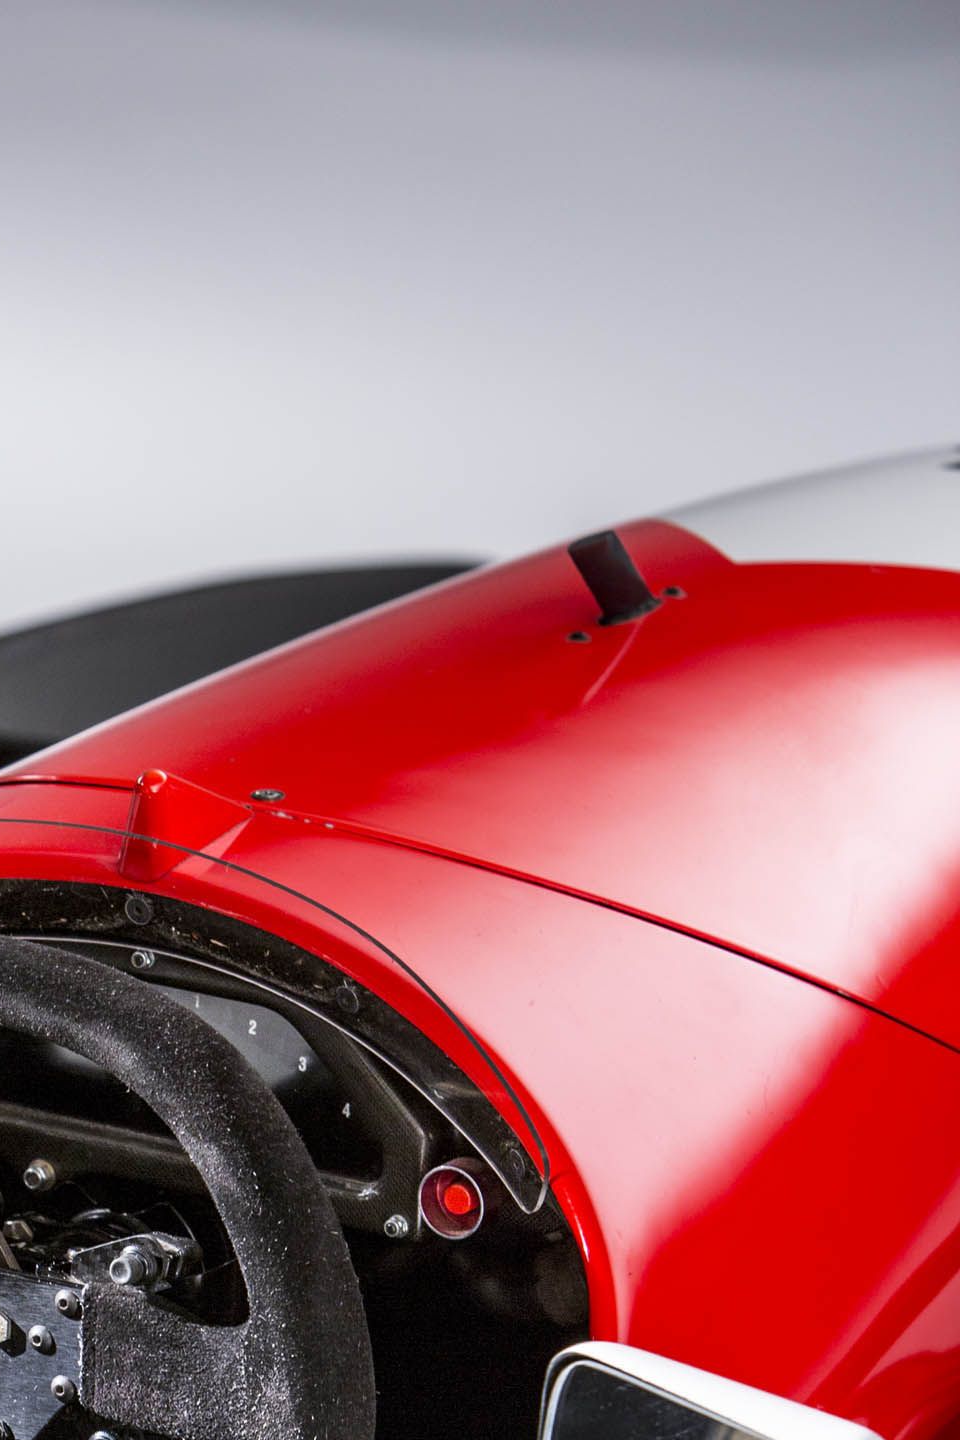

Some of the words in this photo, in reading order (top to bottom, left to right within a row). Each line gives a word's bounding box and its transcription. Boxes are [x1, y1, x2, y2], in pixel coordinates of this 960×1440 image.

[248, 1019, 257, 1035] 2
[298, 1056, 307, 1072] 3
[342, 1102, 351, 1118] 4
